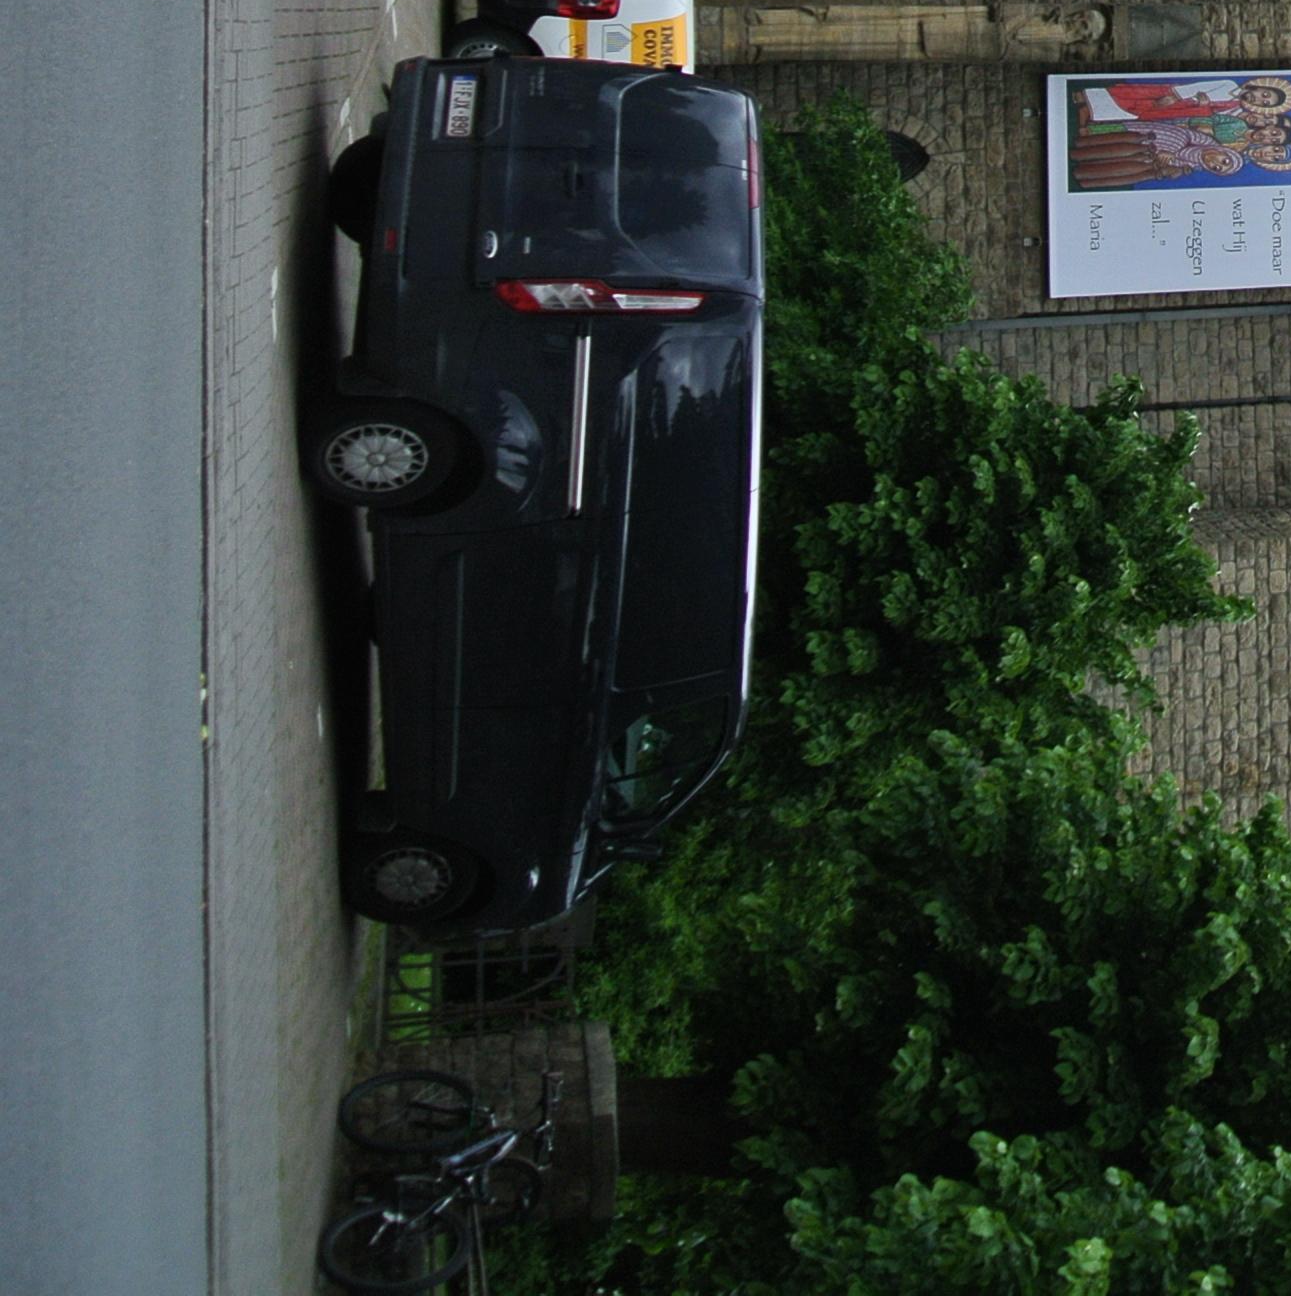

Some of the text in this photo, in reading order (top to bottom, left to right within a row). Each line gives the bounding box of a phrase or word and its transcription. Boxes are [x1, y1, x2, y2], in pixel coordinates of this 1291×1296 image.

[1089, 204, 1105, 252] Maria
[1185, 200, 1206, 277] U zeggen
[1222, 198, 1247, 253] wat Hij
[1271, 236, 1283, 276] maar
